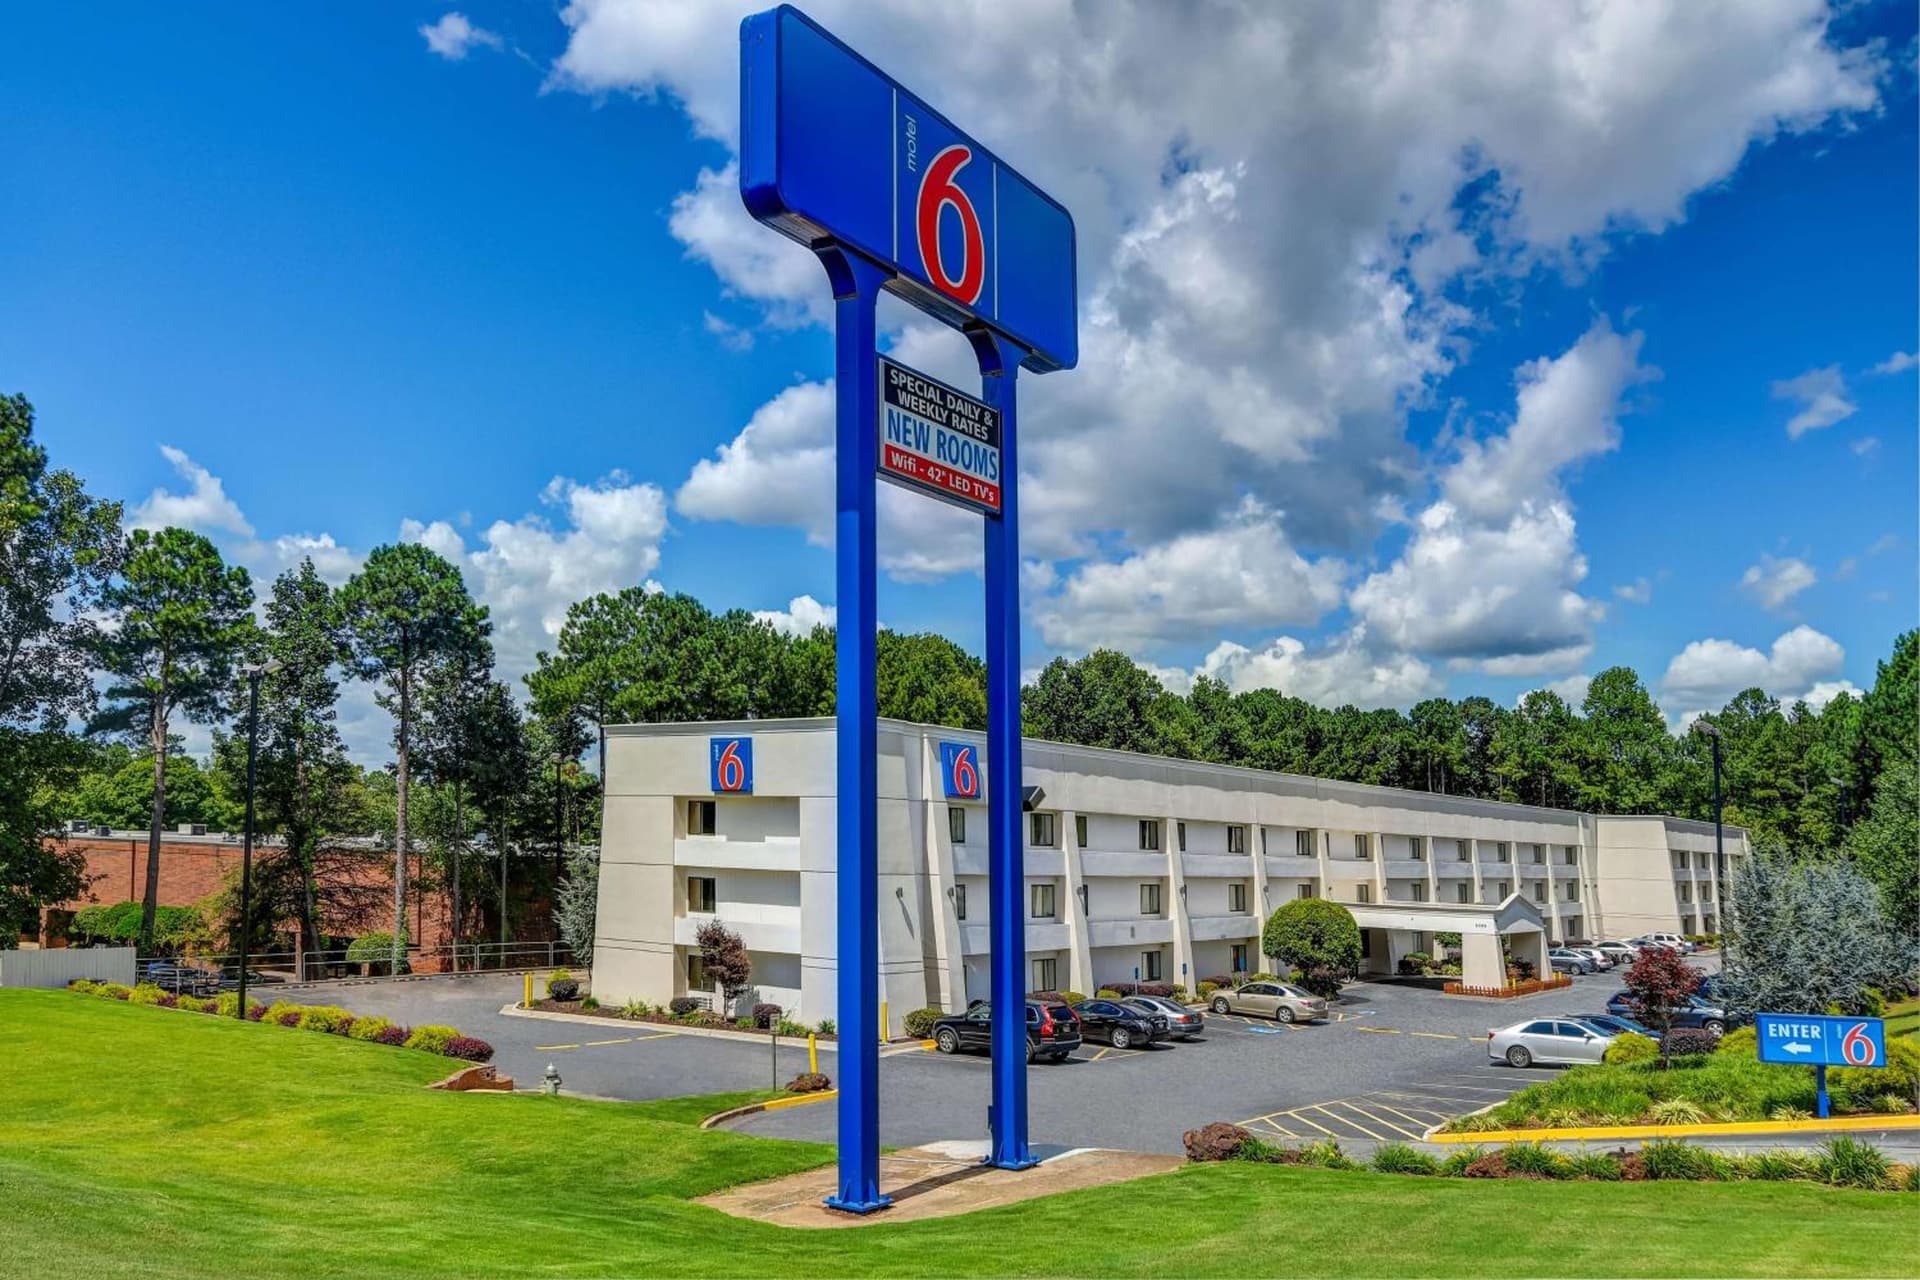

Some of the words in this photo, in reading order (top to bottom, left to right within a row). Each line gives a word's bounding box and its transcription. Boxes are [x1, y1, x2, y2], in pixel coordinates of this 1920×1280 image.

[905, 114, 917, 172] motel
[915, 143, 985, 307] 6
[890, 368, 943, 406] SPECIAL
[947, 393, 981, 421] DAILY
[983, 411, 993, 427] &
[897, 388, 948, 424] WEEKLY
[951, 413, 988, 440] RATES
[887, 408, 930, 454] NEW
[936, 429, 997, 480] ROOMS
[891, 451, 916, 473] Wifi
[949, 473, 970, 492] LED
[973, 482, 994, 501] TV's
[718, 740, 744, 791] 6
[954, 747, 977, 796] 6
[1768, 1023, 1821, 1039] ENTER
[1842, 1022, 1876, 1066] 6
